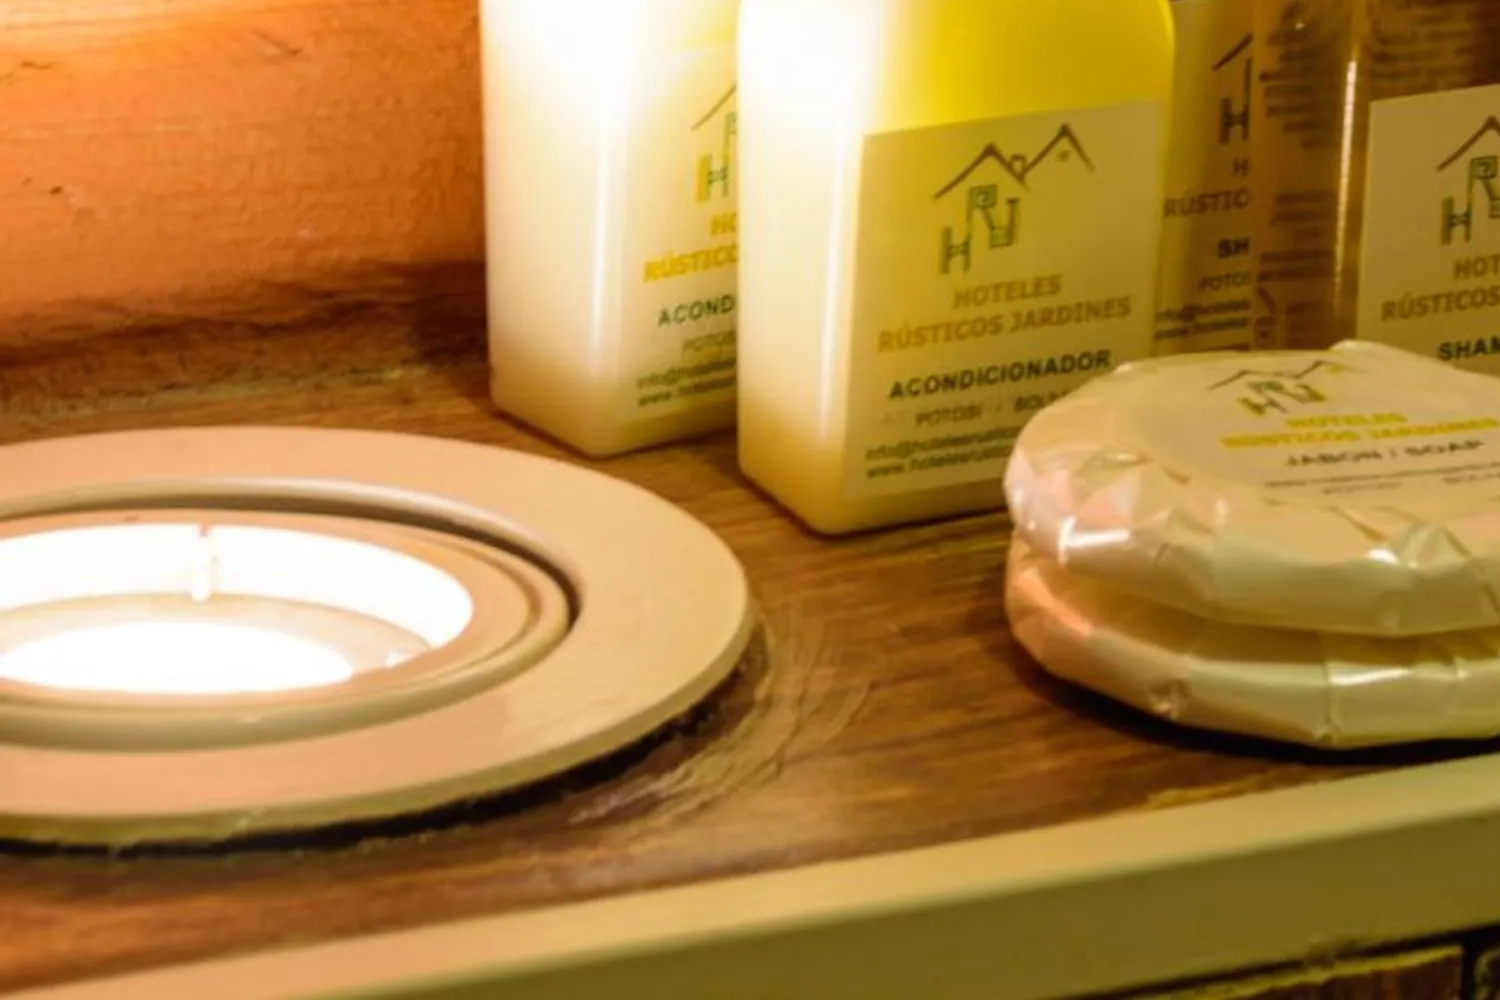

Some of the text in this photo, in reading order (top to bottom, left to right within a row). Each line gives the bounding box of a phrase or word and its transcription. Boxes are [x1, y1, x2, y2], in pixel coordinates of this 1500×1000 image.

[657, 294, 735, 326] ACOND
[952, 274, 1063, 309] HOTELES
[1381, 282, 1500, 322] RÚSTICOS
[877, 310, 1005, 353] RÚSTICOS
[1010, 296, 1132, 333] JARDINES
[890, 350, 1112, 399] ACONDICIONADOR
